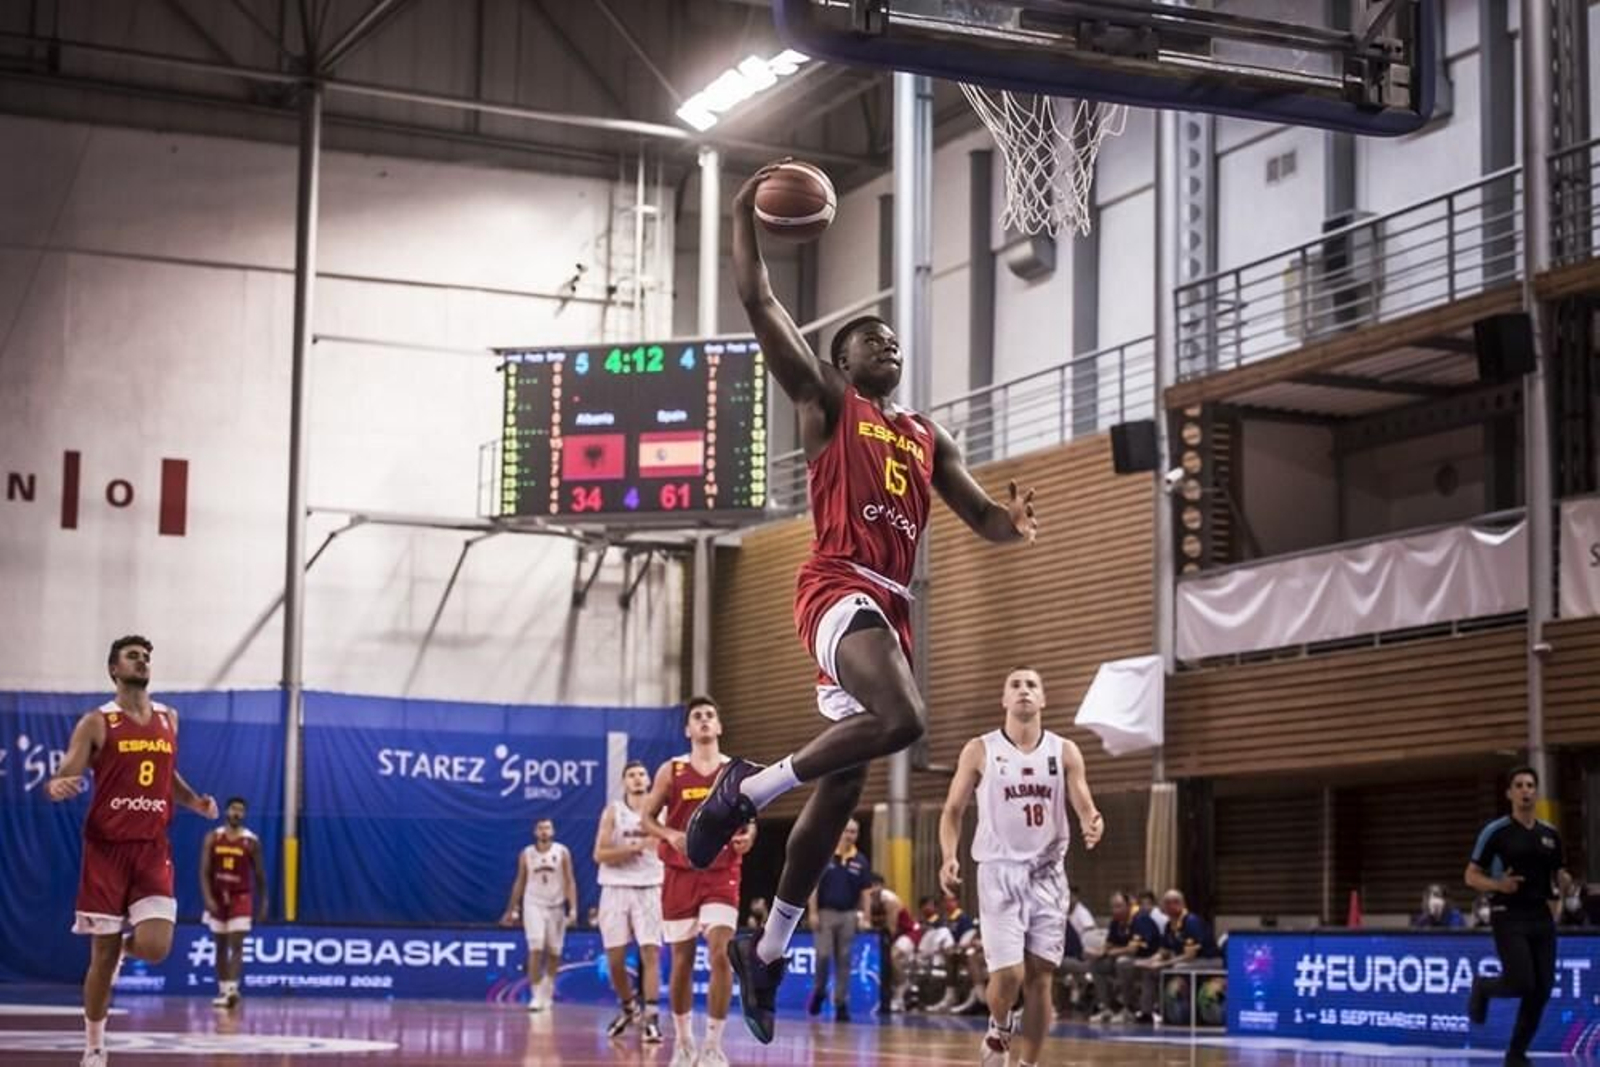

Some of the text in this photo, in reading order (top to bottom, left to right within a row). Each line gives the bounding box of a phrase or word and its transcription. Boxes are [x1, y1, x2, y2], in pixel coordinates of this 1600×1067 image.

[575, 352, 589, 375] 5
[604, 346, 664, 374] 4:12
[679, 347, 695, 370] 4
[885, 456, 908, 496] 15
[571, 486, 602, 512] 34
[623, 487, 640, 509] 4
[660, 484, 691, 510] 61
[118, 739, 173, 755] ESPAÑA
[138, 760, 154, 786] 8
[378, 749, 598, 796] STAREZ SPORT
[1023, 803, 1044, 828] 18
[350, 975, 393, 989] 2022
[1340, 1009, 1427, 1030] SEPTEMBER
[1430, 1014, 1470, 1033] 2022
